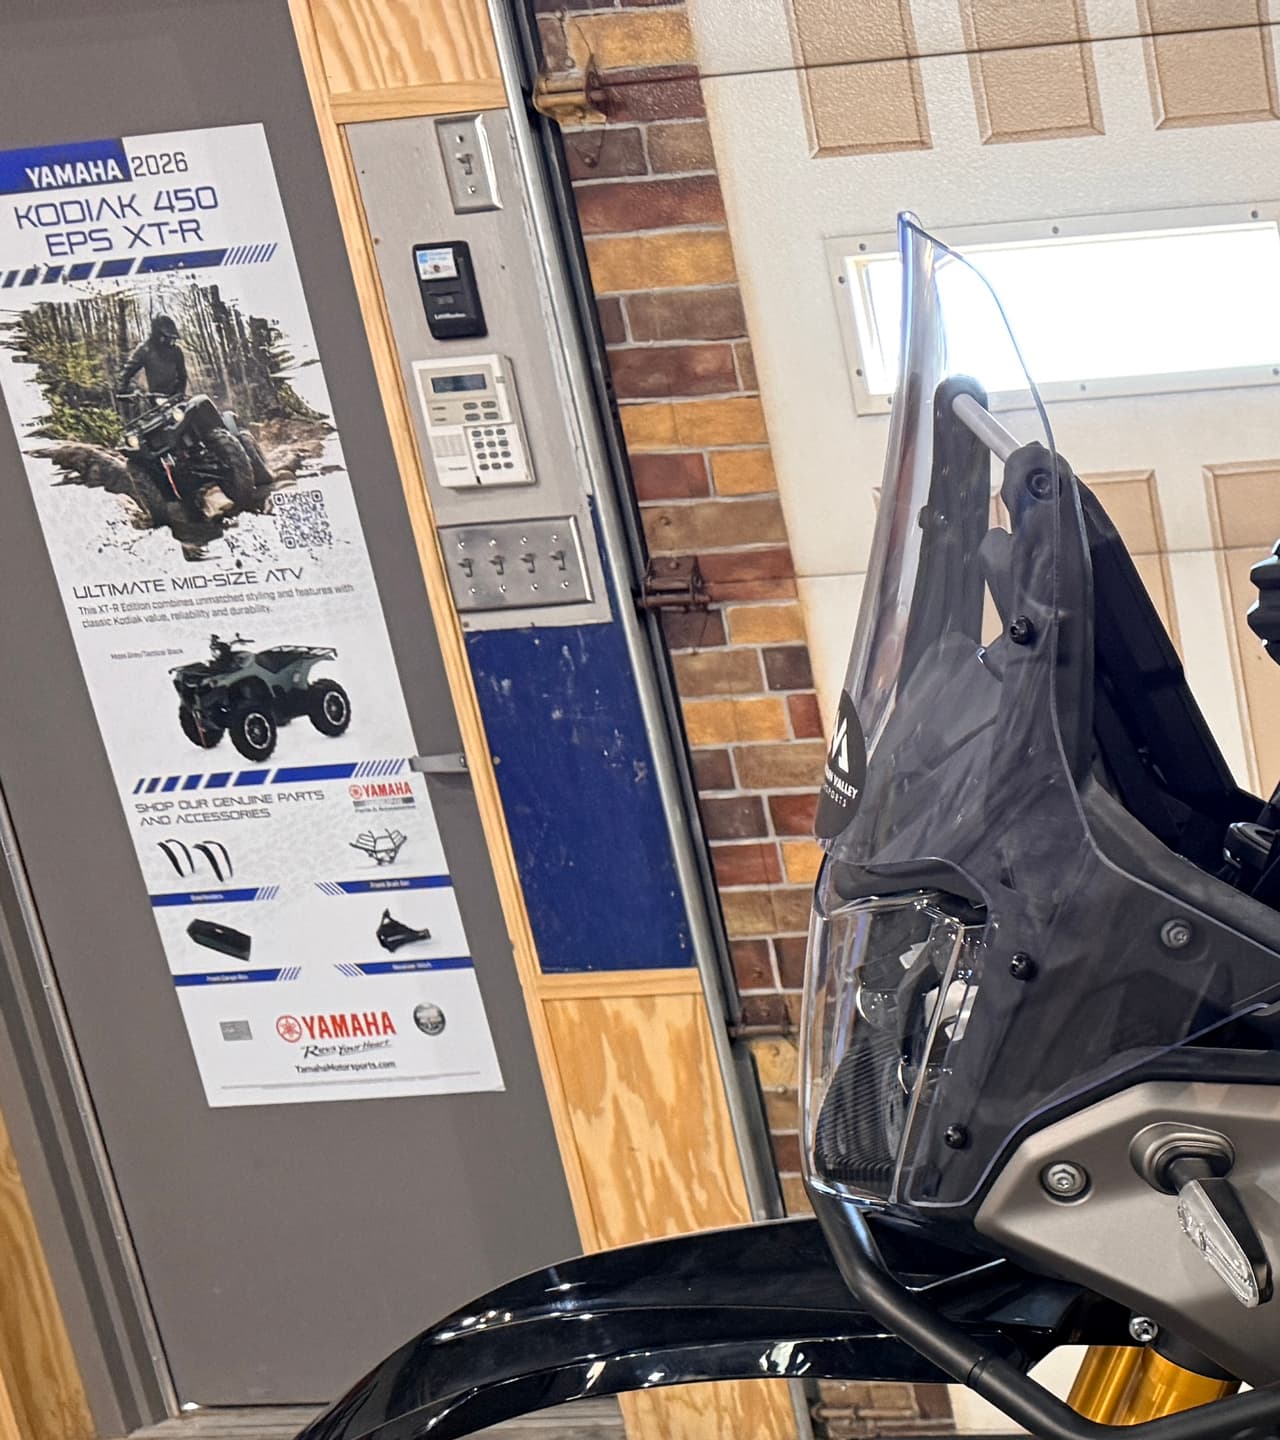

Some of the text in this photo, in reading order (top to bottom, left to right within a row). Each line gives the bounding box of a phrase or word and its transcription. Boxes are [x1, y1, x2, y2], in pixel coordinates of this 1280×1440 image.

[25, 151, 189, 189] YAMAHA 2026
[14, 185, 219, 230] KODIAK 450
[45, 218, 204, 257] EPS XT-R
[73, 567, 304, 600] ULTIMATE MID-SIZE ATV
[98, 603, 120, 615] XT-R
[121, 601, 152, 613] Edition
[277, 588, 294, 599] and
[334, 583, 355, 594] with
[113, 614, 143, 626] Kodiak
[212, 606, 229, 617] and
[362, 781, 413, 798] YAMAHA
[833, 773, 859, 800] VALLEY
[135, 789, 326, 814] SHOP OUR GENUINE PARTS
[140, 807, 272, 827] AND ACCESSORIES
[301, 1011, 397, 1040] YAMAHA
[294, 1061, 397, 1074] YamahaMotorsports.com
